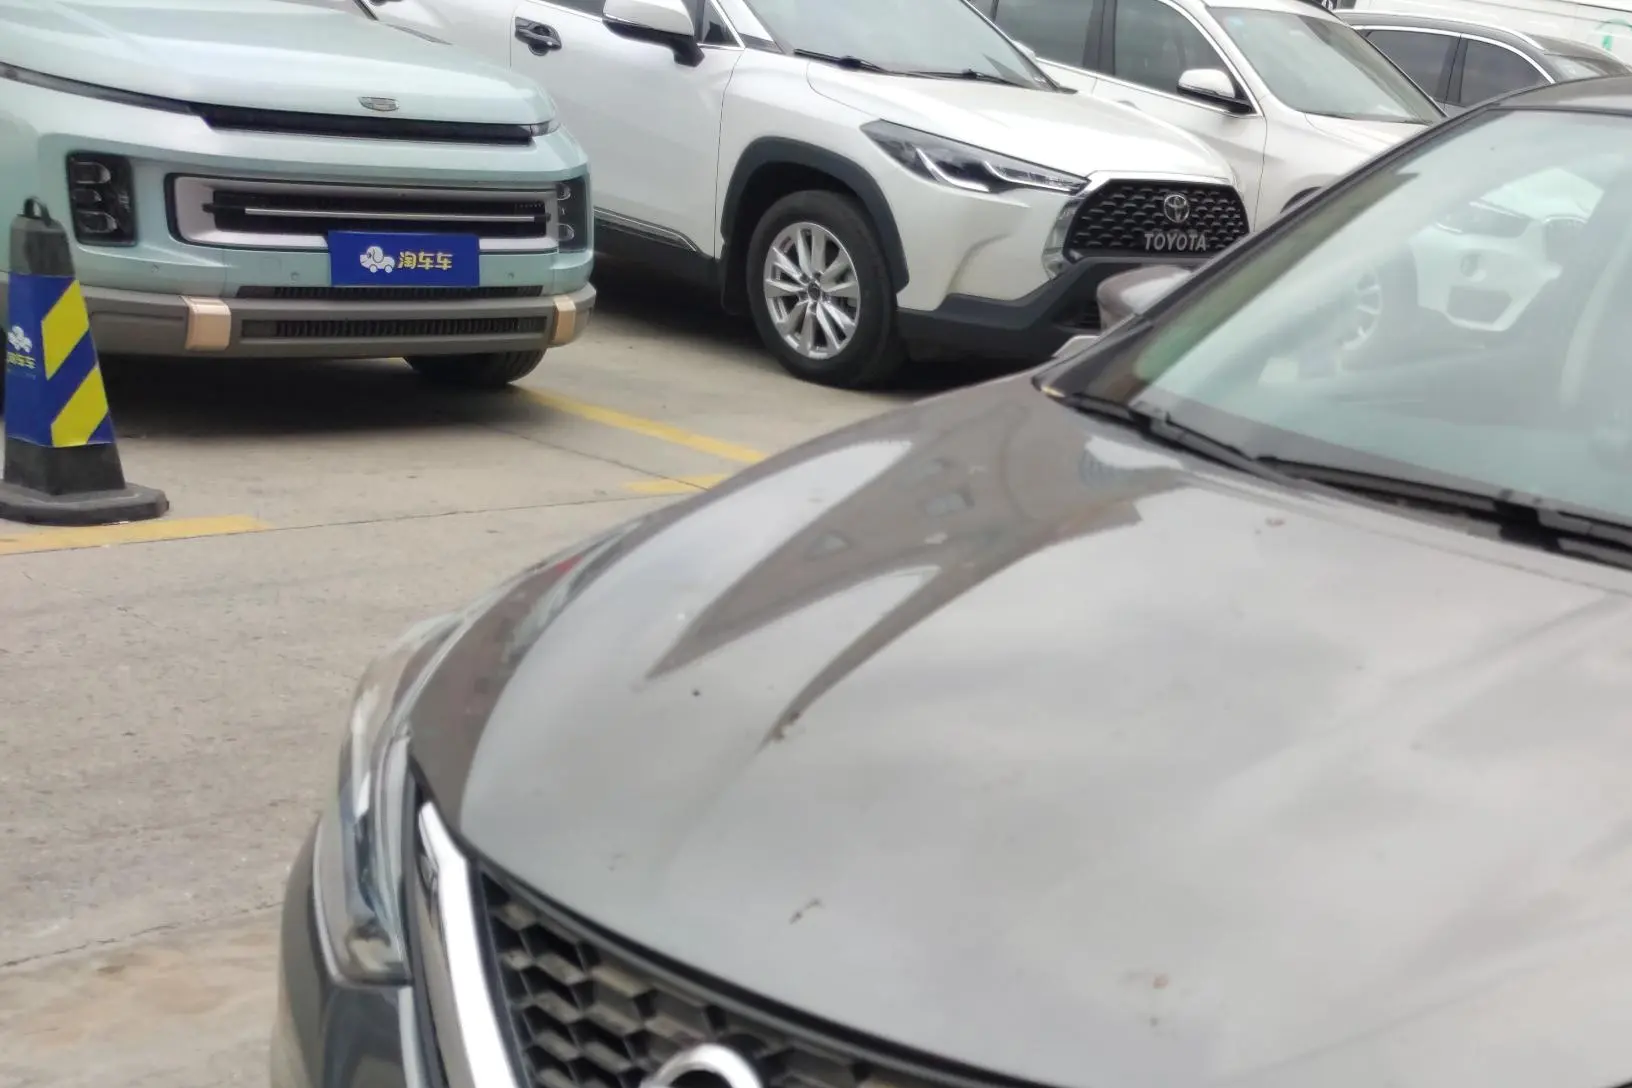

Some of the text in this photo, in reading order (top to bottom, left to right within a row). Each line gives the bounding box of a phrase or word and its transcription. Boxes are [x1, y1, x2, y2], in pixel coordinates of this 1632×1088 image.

[1143, 232, 1207, 251] TOYOTA
[397, 251, 454, 270] 淘车车
